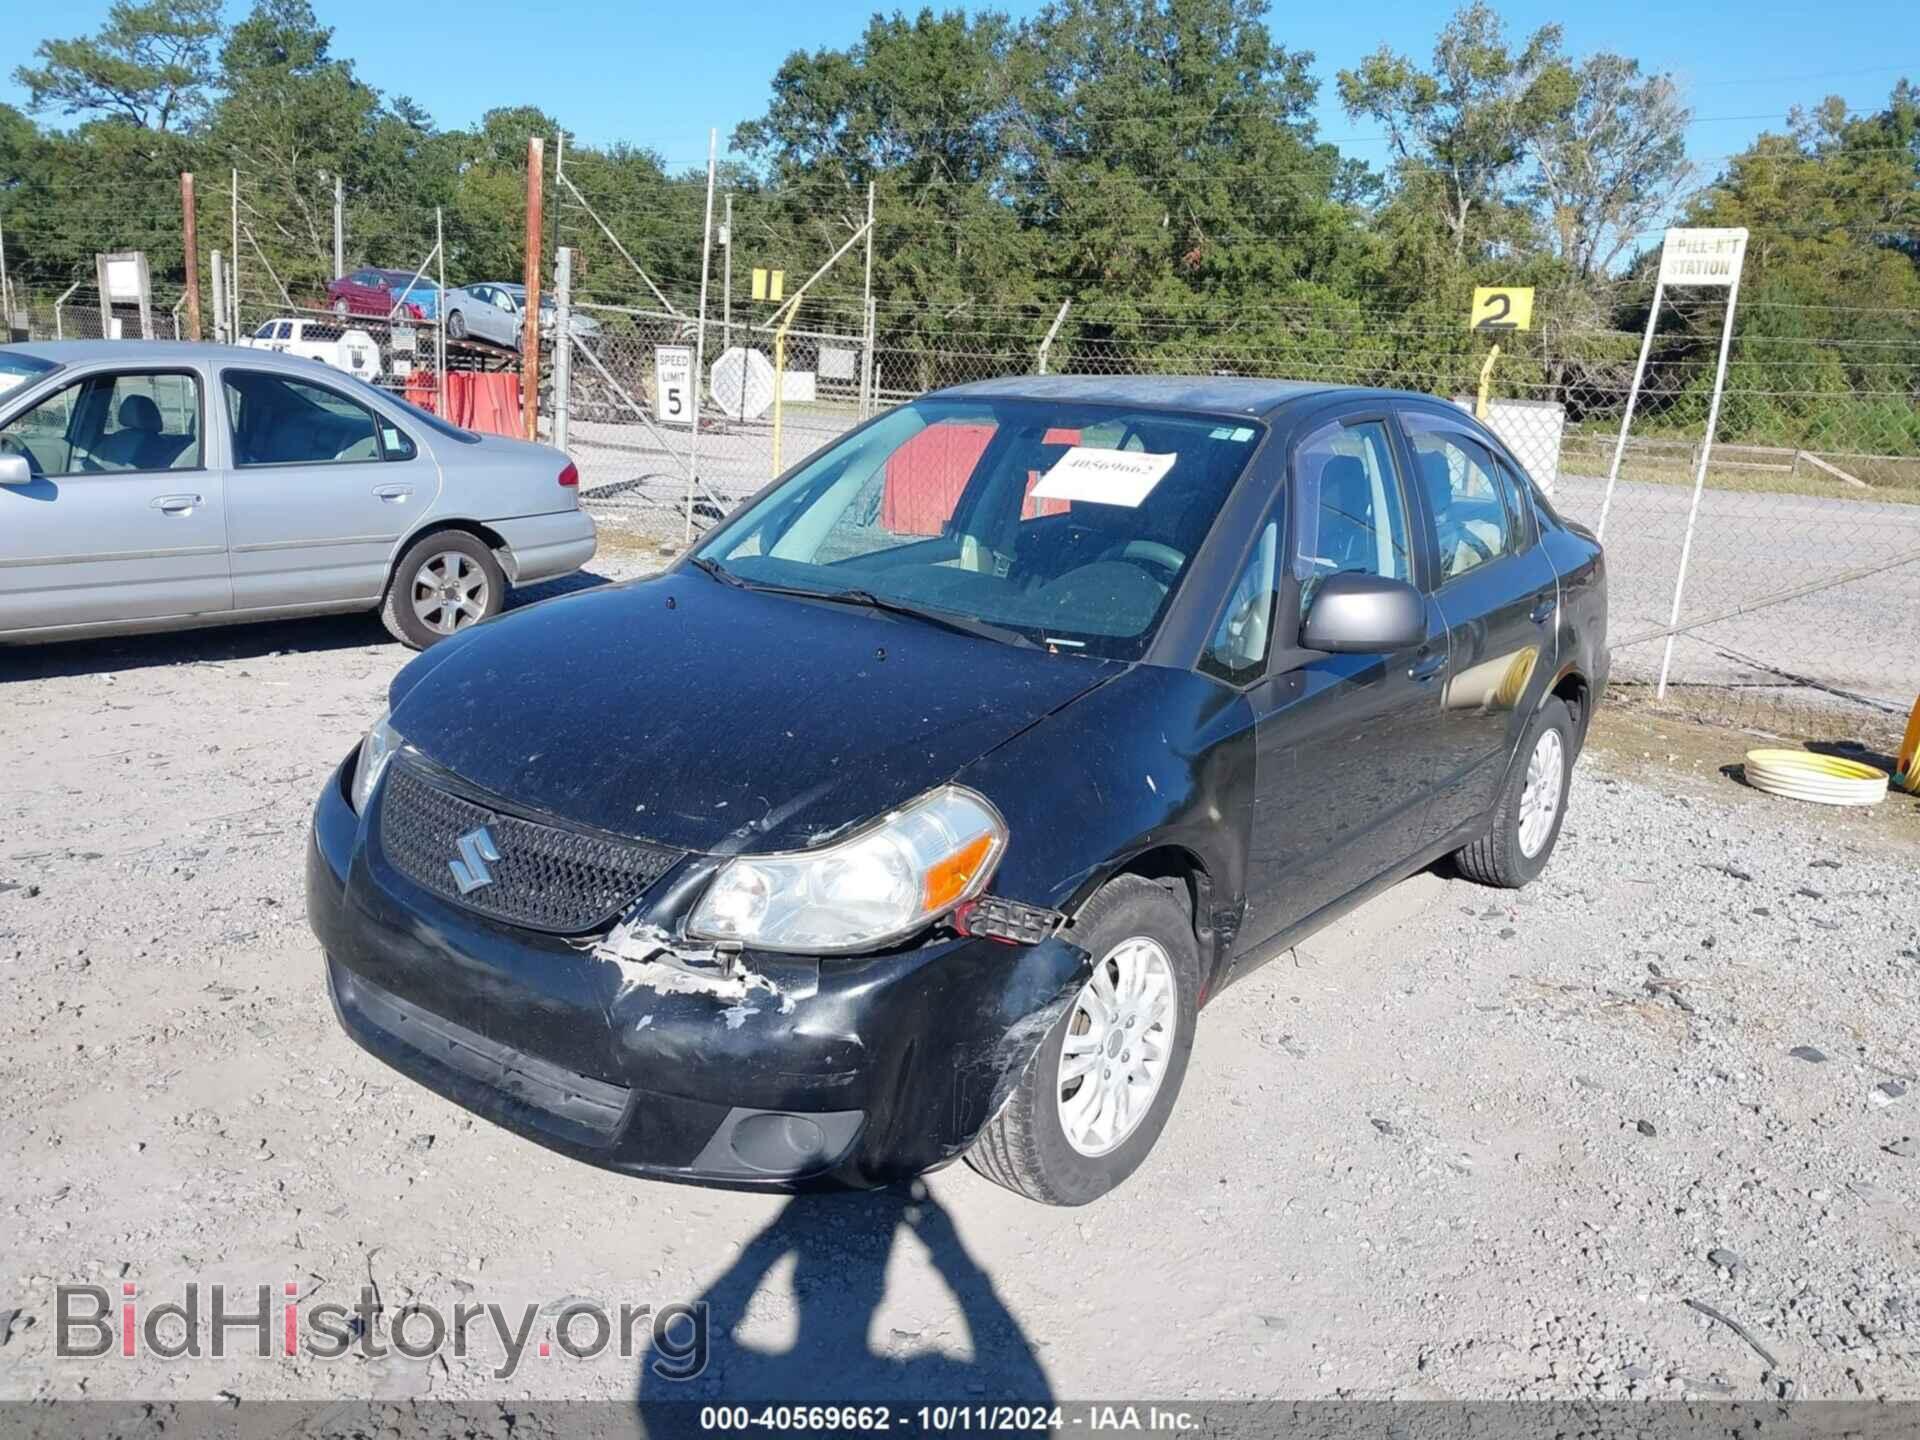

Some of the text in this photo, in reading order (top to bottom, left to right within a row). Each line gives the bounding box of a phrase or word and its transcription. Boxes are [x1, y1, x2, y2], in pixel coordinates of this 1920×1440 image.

[1669, 259, 1730, 275] STATION
[1476, 293, 1518, 328] 2
[659, 354, 689, 366] SPEED
[662, 371, 686, 382] LIMIT
[668, 388, 682, 415] 5
